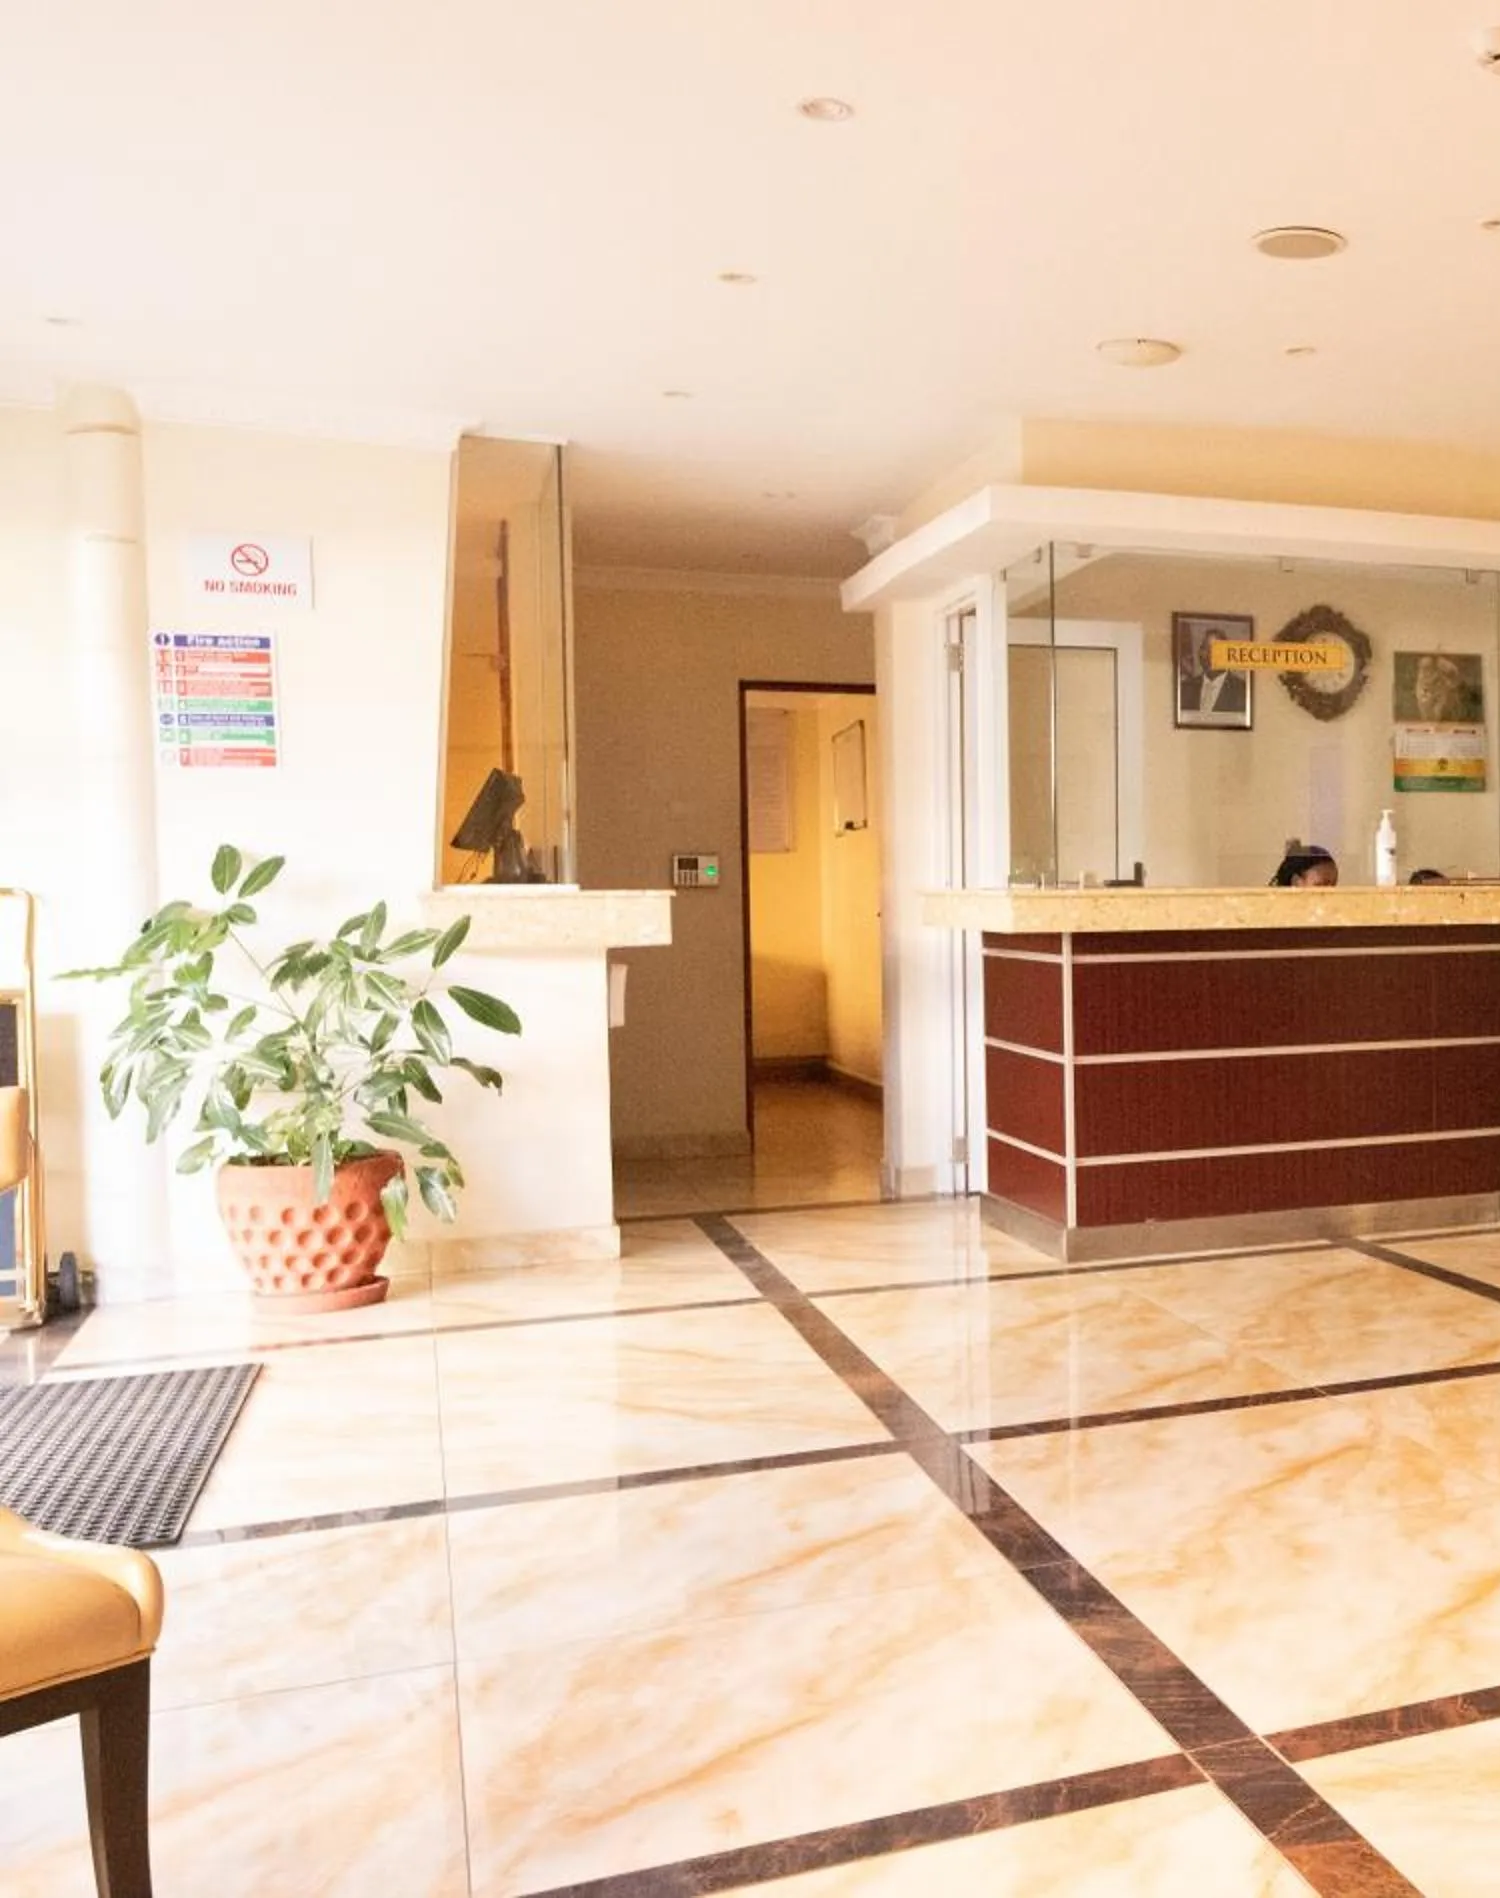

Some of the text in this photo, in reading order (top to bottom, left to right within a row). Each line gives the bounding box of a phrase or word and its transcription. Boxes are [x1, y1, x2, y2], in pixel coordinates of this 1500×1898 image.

[204, 580, 298, 596] NO SMOKING
[1227, 647, 1328, 664] RECEPTION
